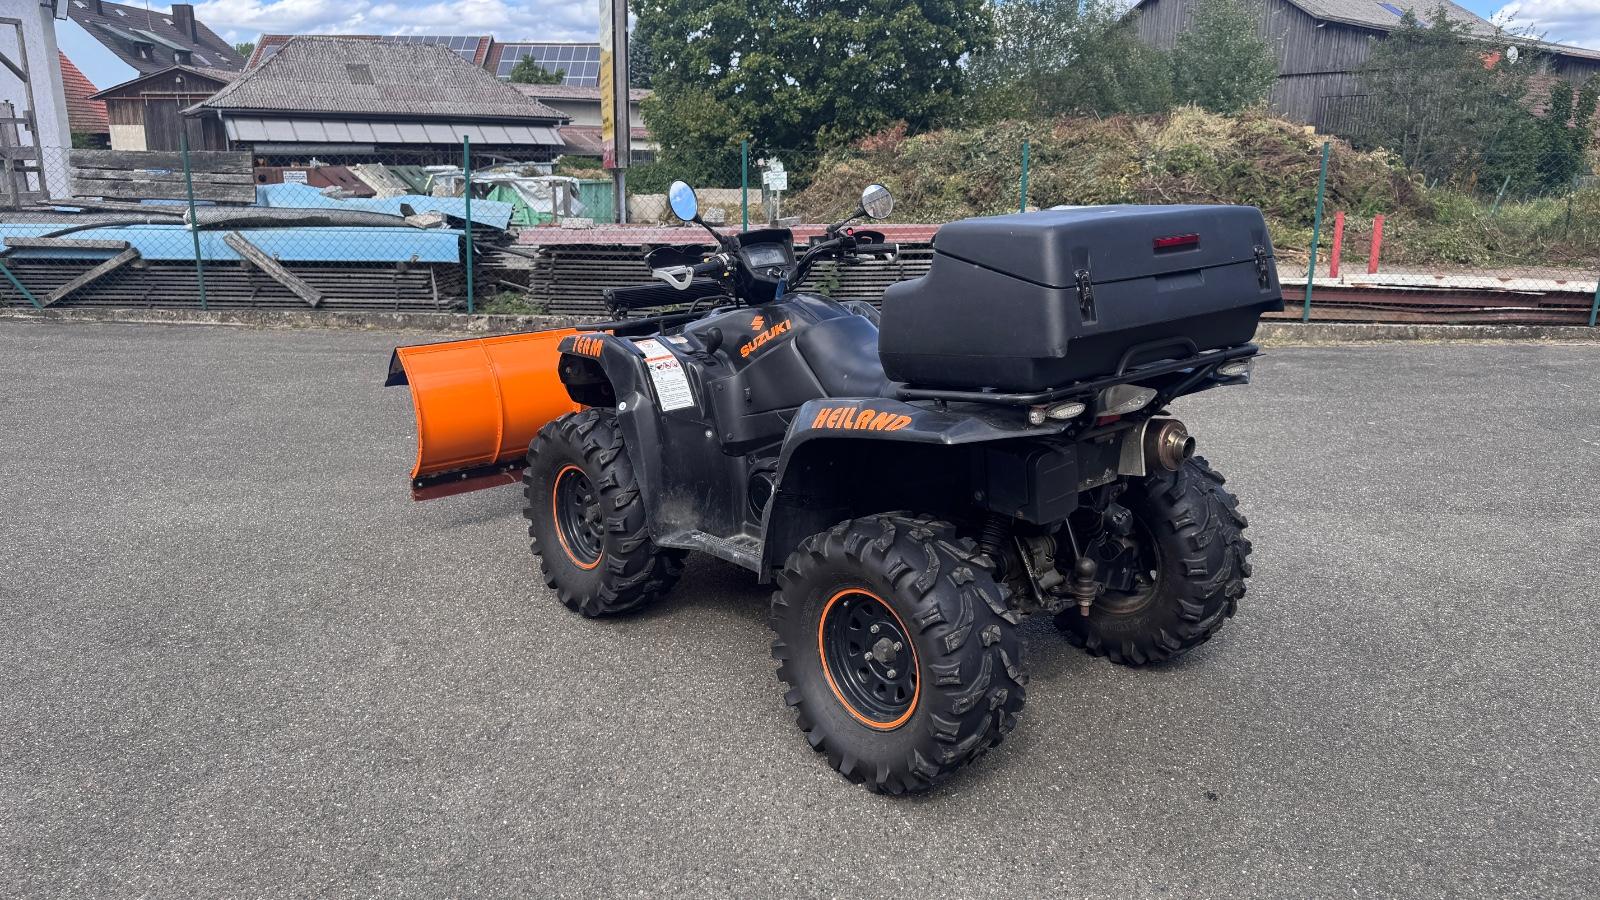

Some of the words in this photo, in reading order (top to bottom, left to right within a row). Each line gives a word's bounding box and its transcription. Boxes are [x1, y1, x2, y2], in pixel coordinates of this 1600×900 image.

[572, 336, 603, 357] TEAM
[740, 319, 791, 358] SUZUKI
[811, 407, 912, 431] HEILAND
